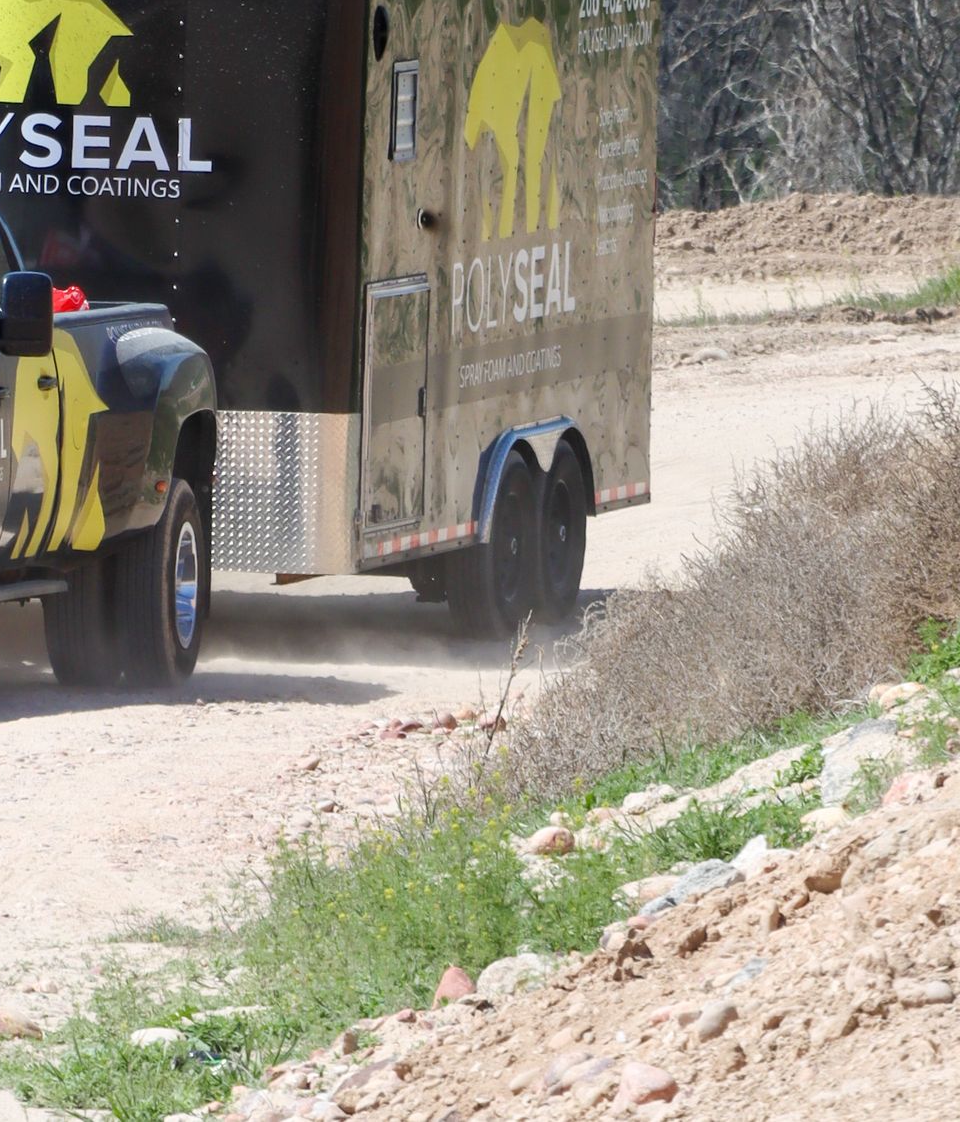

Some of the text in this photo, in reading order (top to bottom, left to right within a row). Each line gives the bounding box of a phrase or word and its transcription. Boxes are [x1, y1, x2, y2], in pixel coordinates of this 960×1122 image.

[8, 174, 59, 196] AND
[66, 177, 181, 199] COATINGS
[452, 241, 575, 335] POLYSEAL
[459, 345, 562, 389] SPRAY FOAM AND COATINGS
